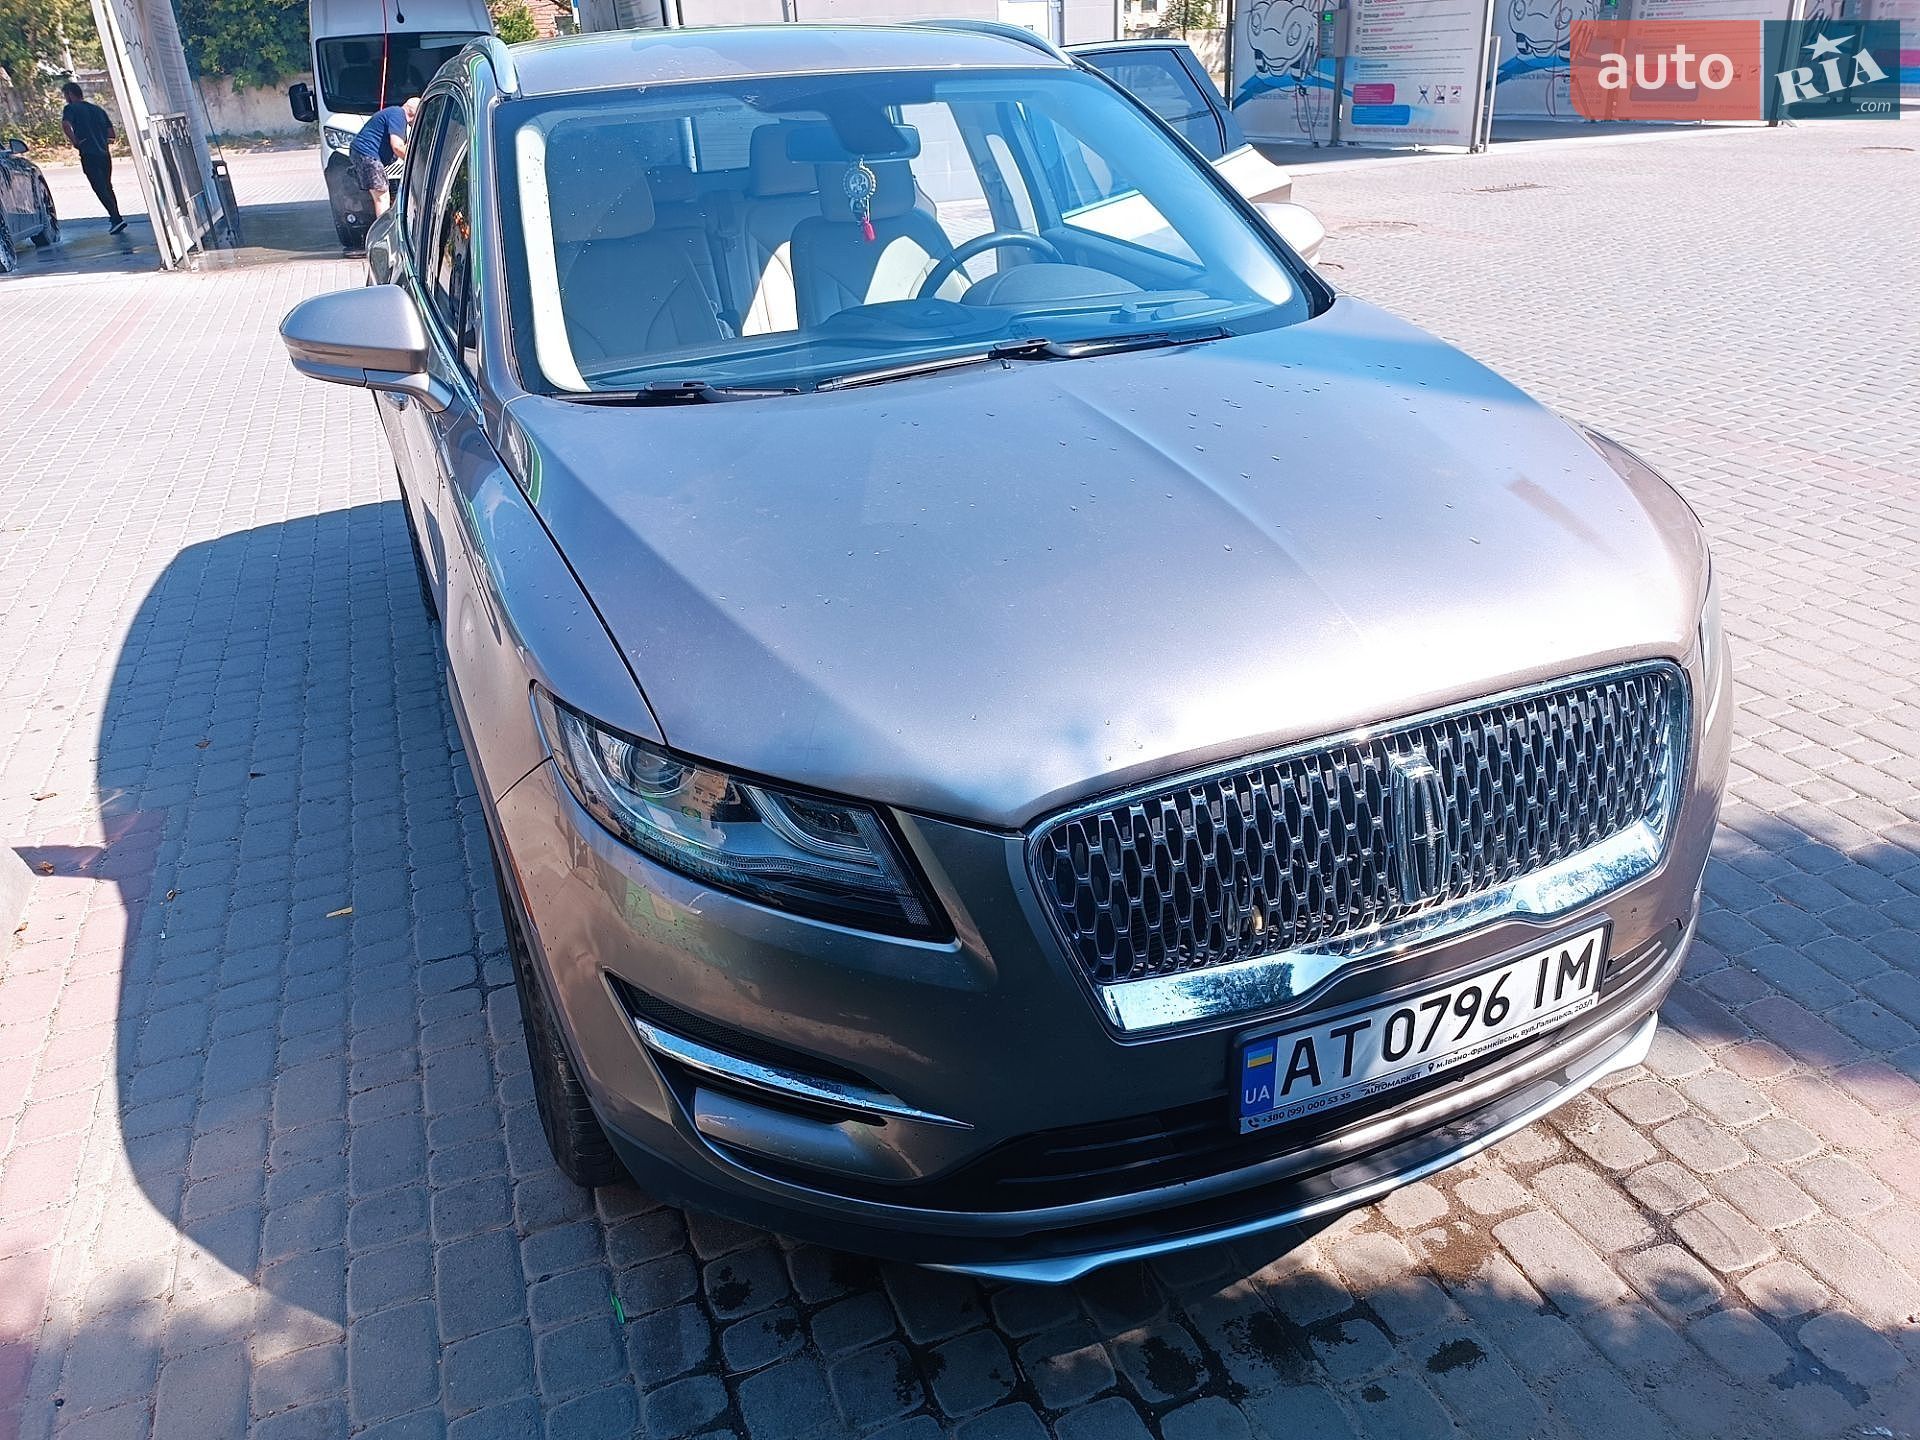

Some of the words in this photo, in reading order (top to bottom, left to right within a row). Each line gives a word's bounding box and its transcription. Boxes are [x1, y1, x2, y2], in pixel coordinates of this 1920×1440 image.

[1534, 939, 1594, 1010] IM
[1245, 1085, 1270, 1105] UA
[1363, 1071, 1422, 1096] AUTOMARKET
[1287, 1105, 1305, 1118] (99)
[1307, 1099, 1326, 1111] 000
[1327, 1095, 1339, 1105] 53
[1340, 1091, 1352, 1101] 35
